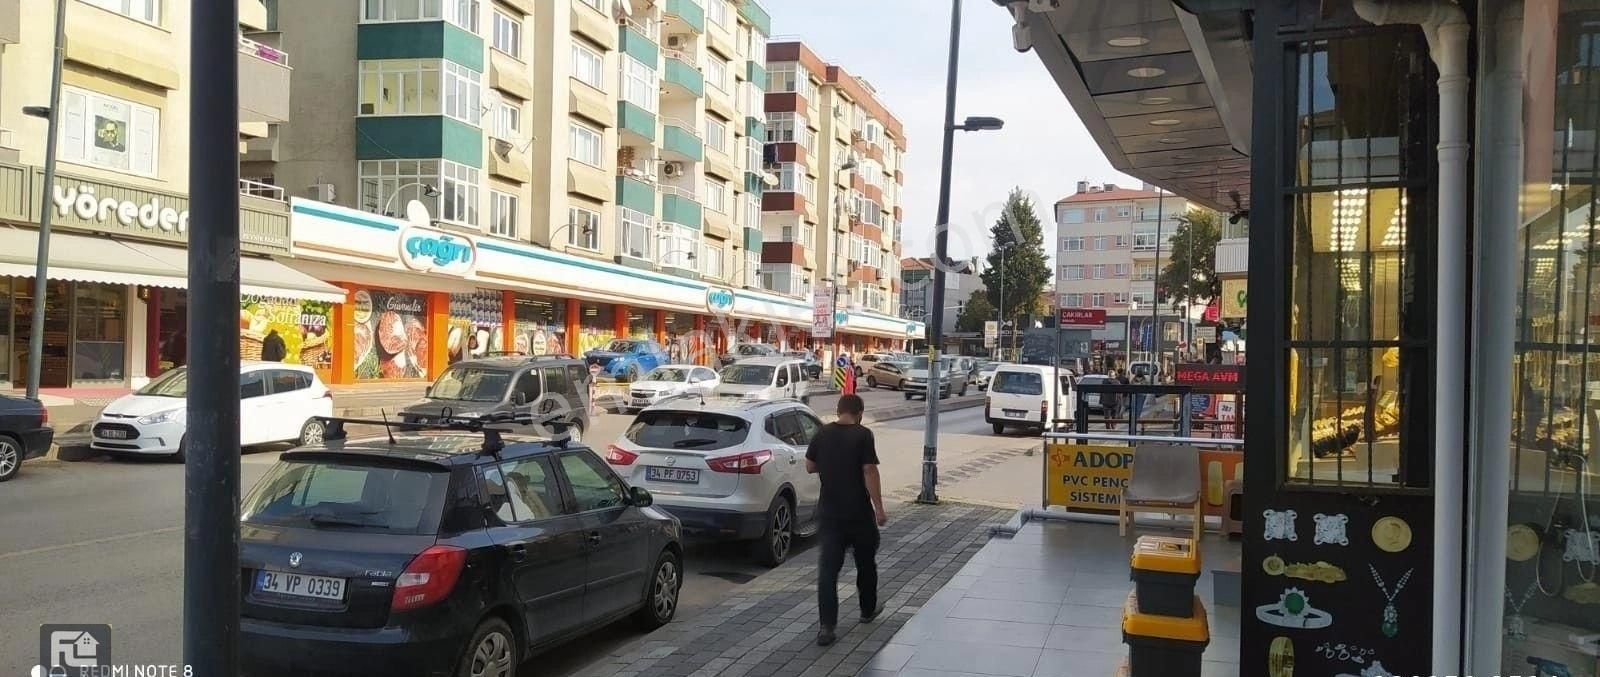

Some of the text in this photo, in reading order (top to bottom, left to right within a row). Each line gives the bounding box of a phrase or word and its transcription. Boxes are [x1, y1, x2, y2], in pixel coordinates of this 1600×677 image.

[406, 236, 470, 266] çağrı
[1177, 371, 1239, 382] MEGA AVM
[650, 469, 660, 479] 34
[676, 469, 696, 481] 0753
[1063, 475, 1088, 486] PVC
[263, 571, 340, 597] 34 VP 0339
